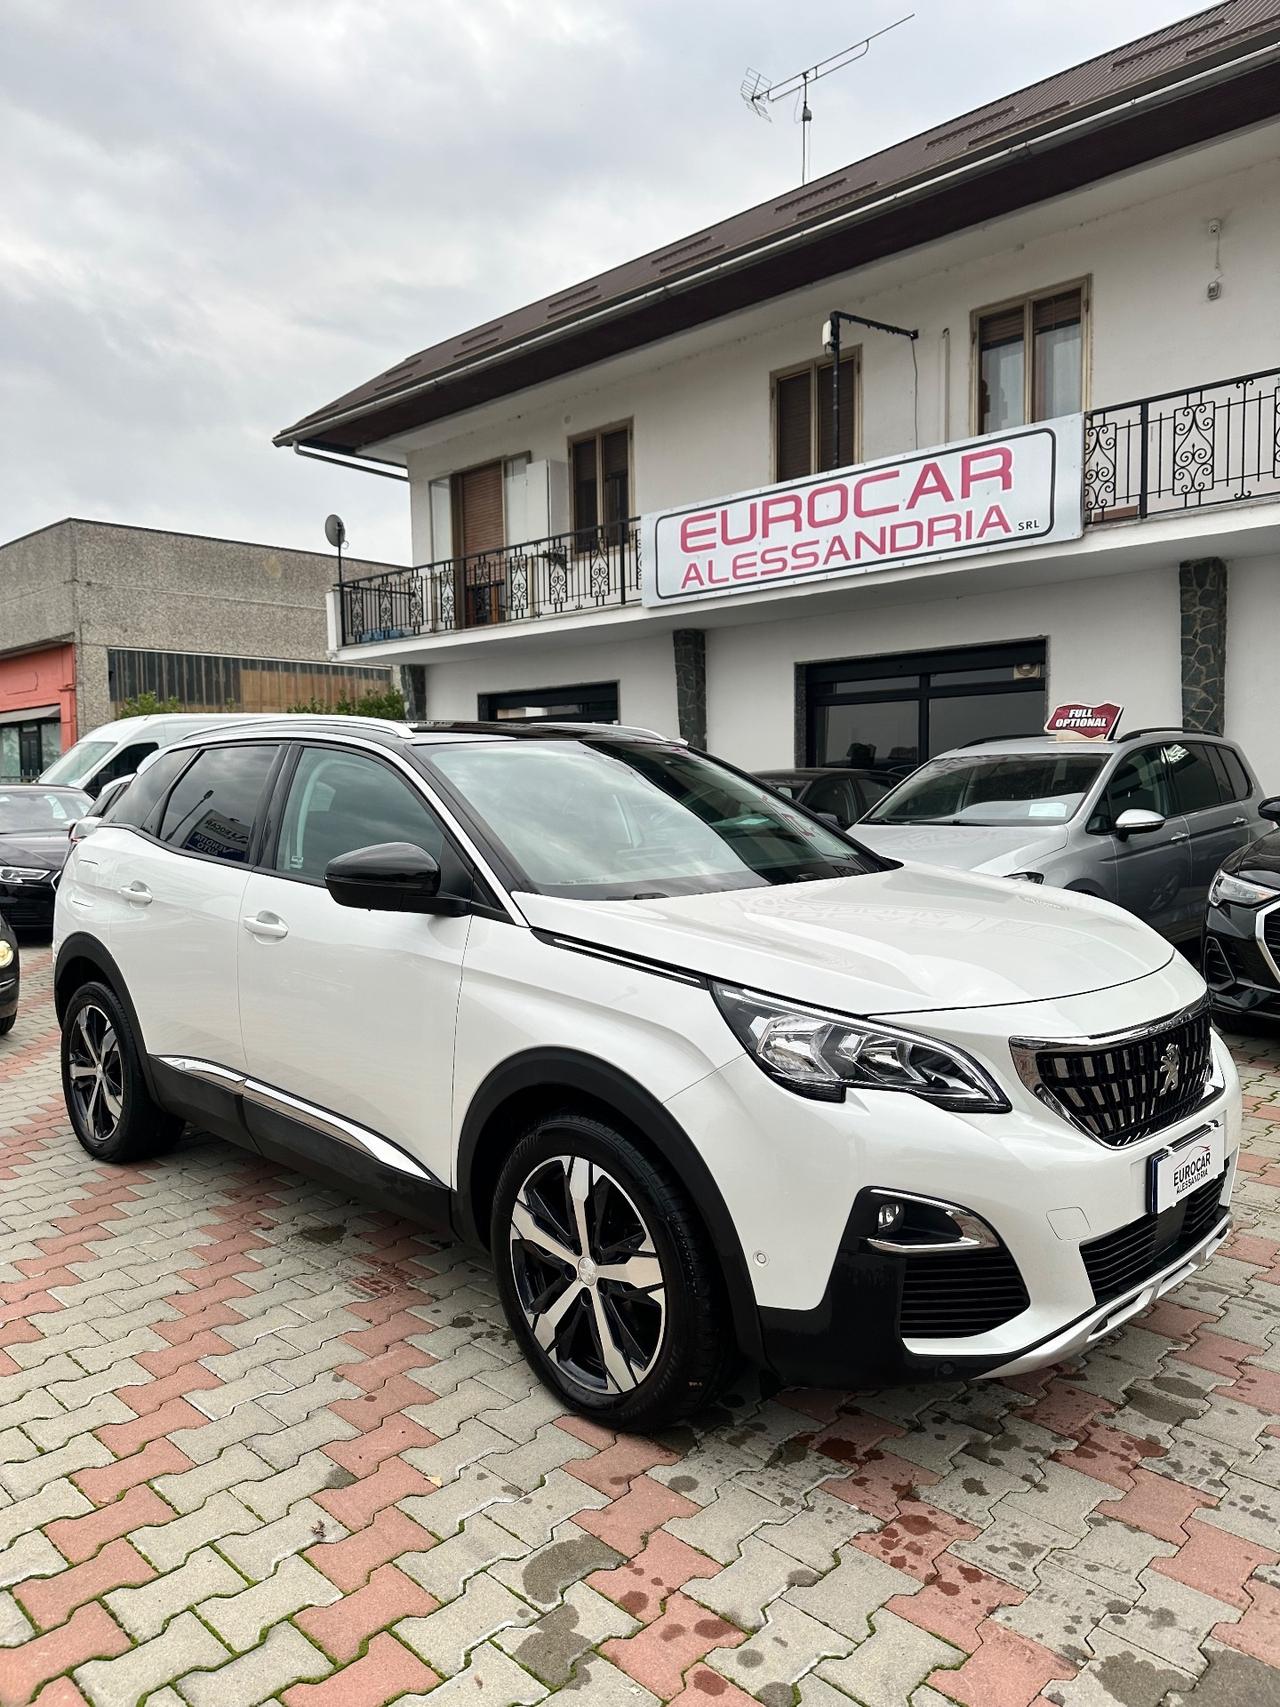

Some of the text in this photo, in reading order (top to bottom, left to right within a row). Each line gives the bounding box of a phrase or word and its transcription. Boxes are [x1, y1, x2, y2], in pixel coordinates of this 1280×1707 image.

[680, 446, 1012, 553] EUROCAR
[1017, 519, 1040, 531] SRL
[681, 504, 1012, 589] ALESSANDRIA
[1055, 718, 1107, 728] OPTIONAL
[1069, 708, 1093, 718] FULL
[1173, 1152, 1211, 1187] EUROCAR
[1176, 1169, 1208, 1194] ALESSANDRIA
